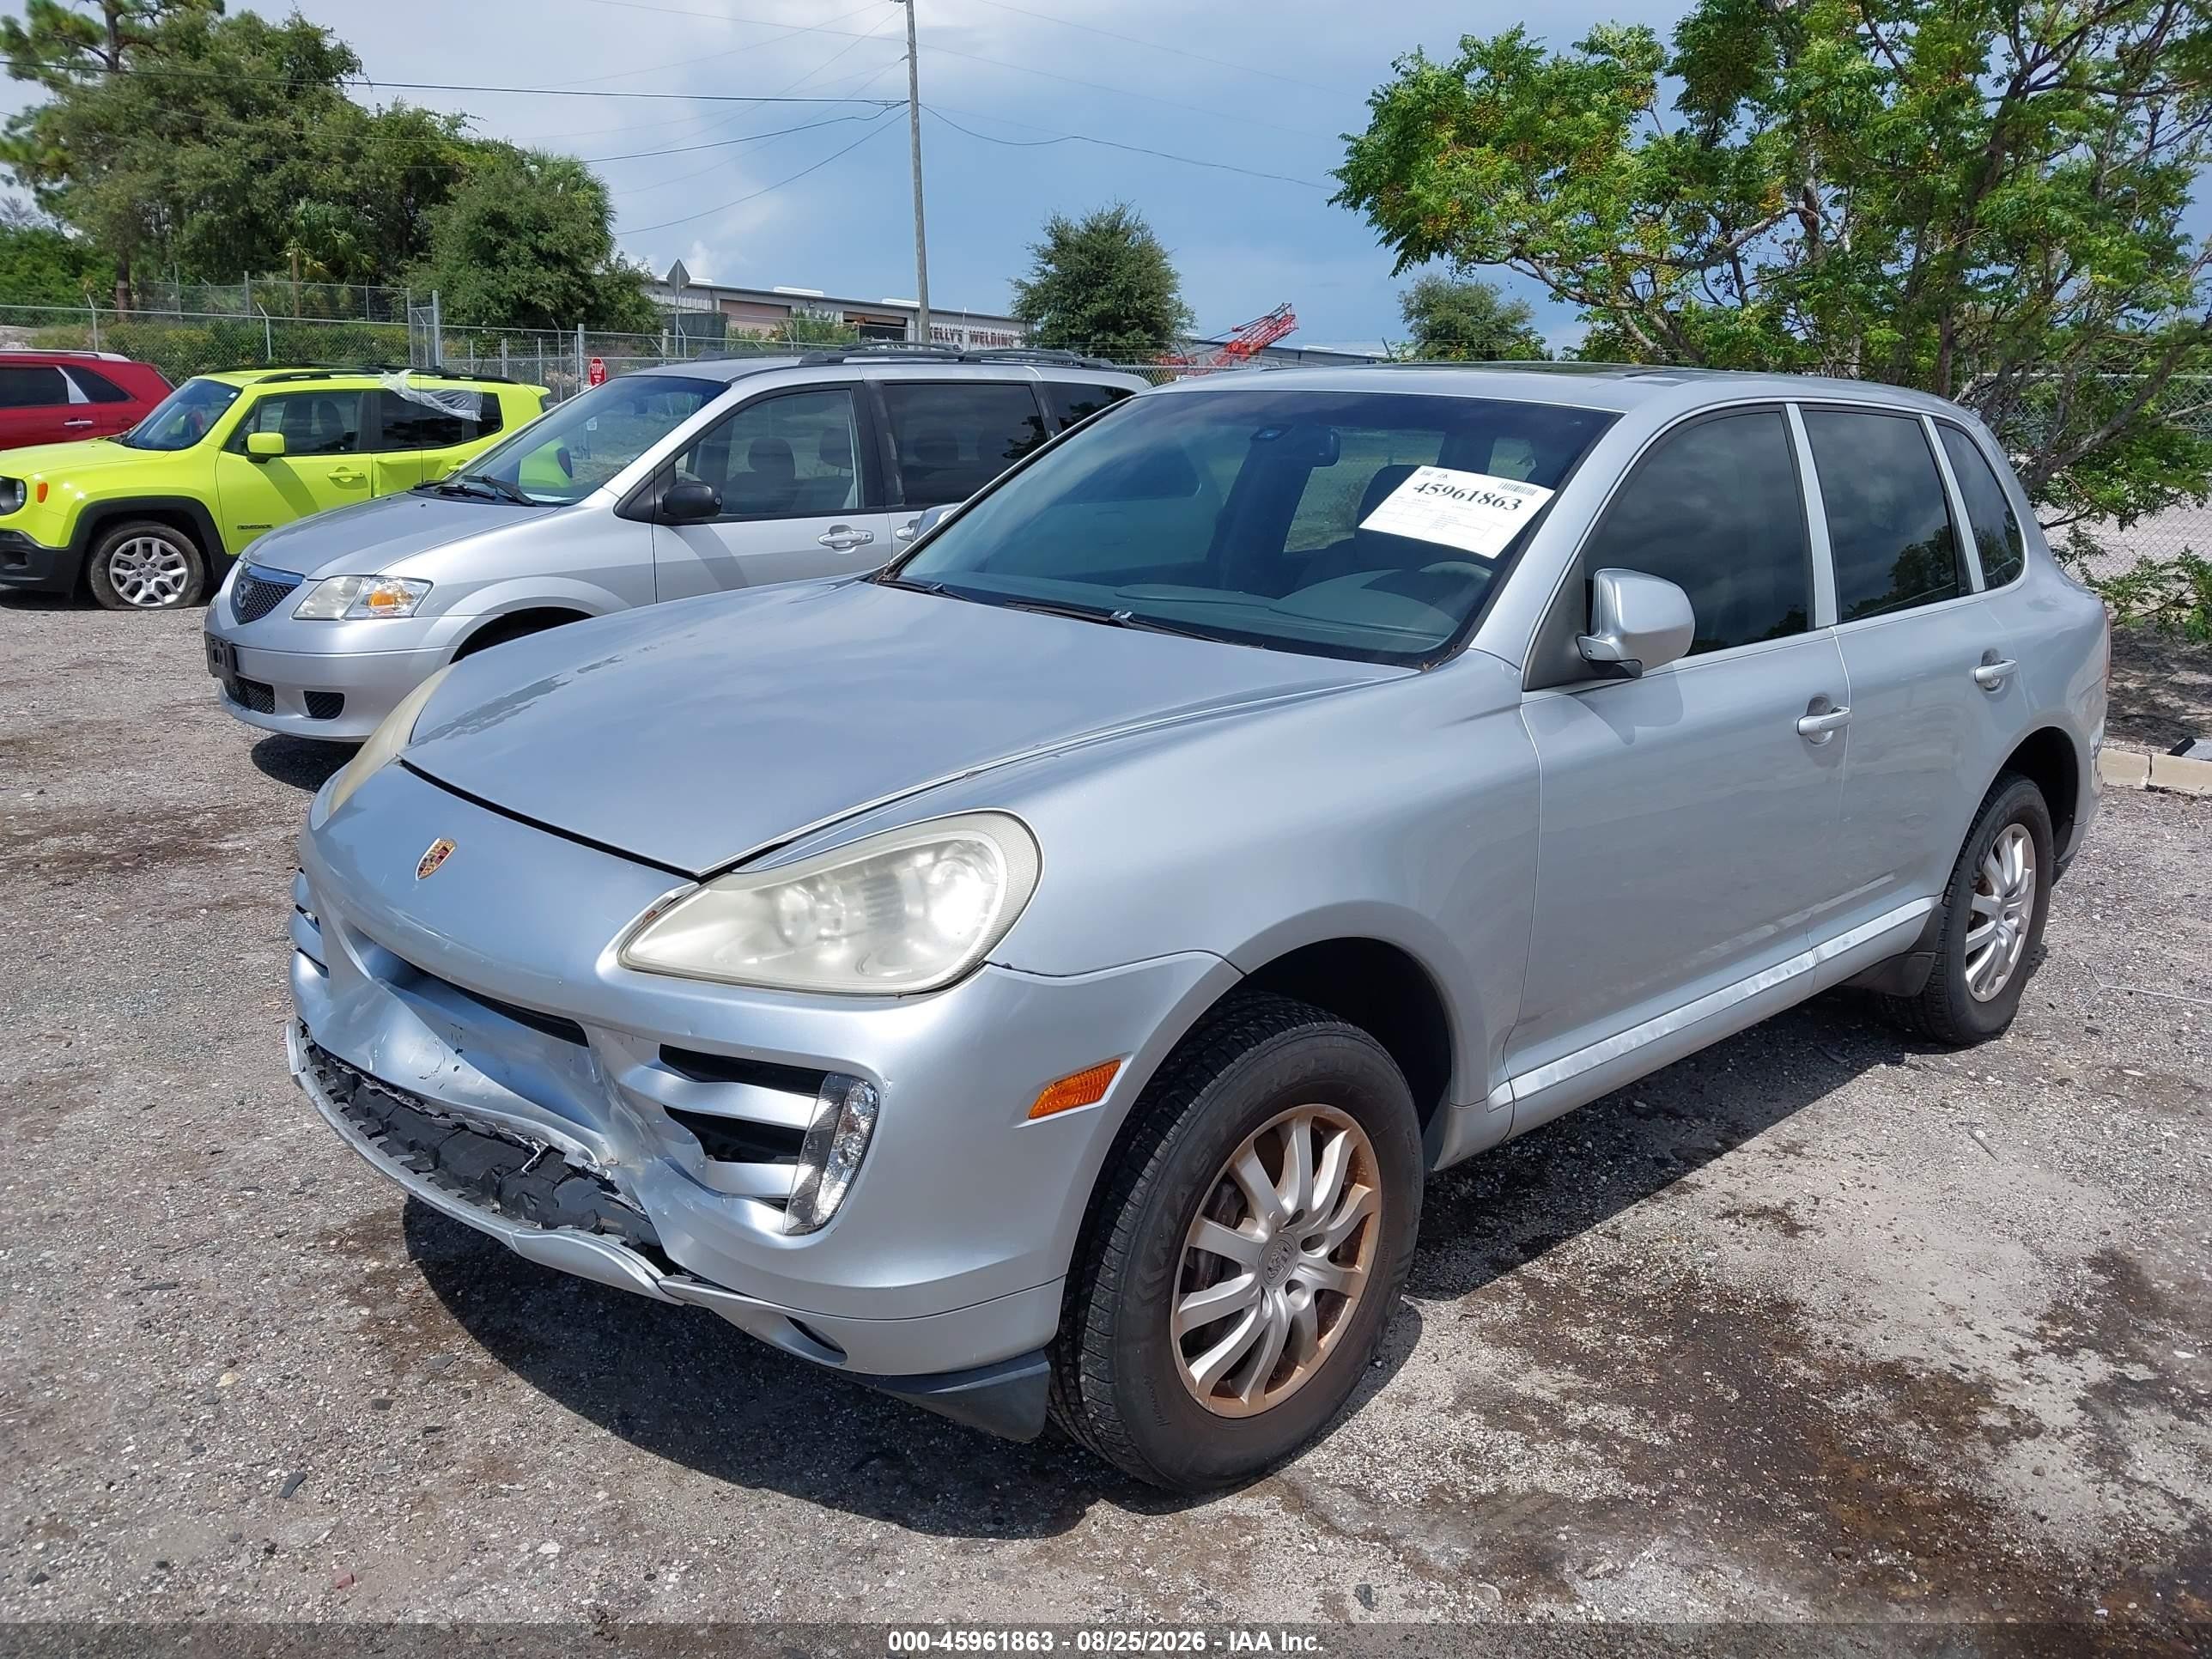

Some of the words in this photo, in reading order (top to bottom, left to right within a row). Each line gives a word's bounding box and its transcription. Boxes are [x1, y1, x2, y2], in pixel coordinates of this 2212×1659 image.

[969, 330, 1014, 346] WELDING
[591, 363, 603, 374] STOP
[1413, 483, 1522, 511] 45961863
